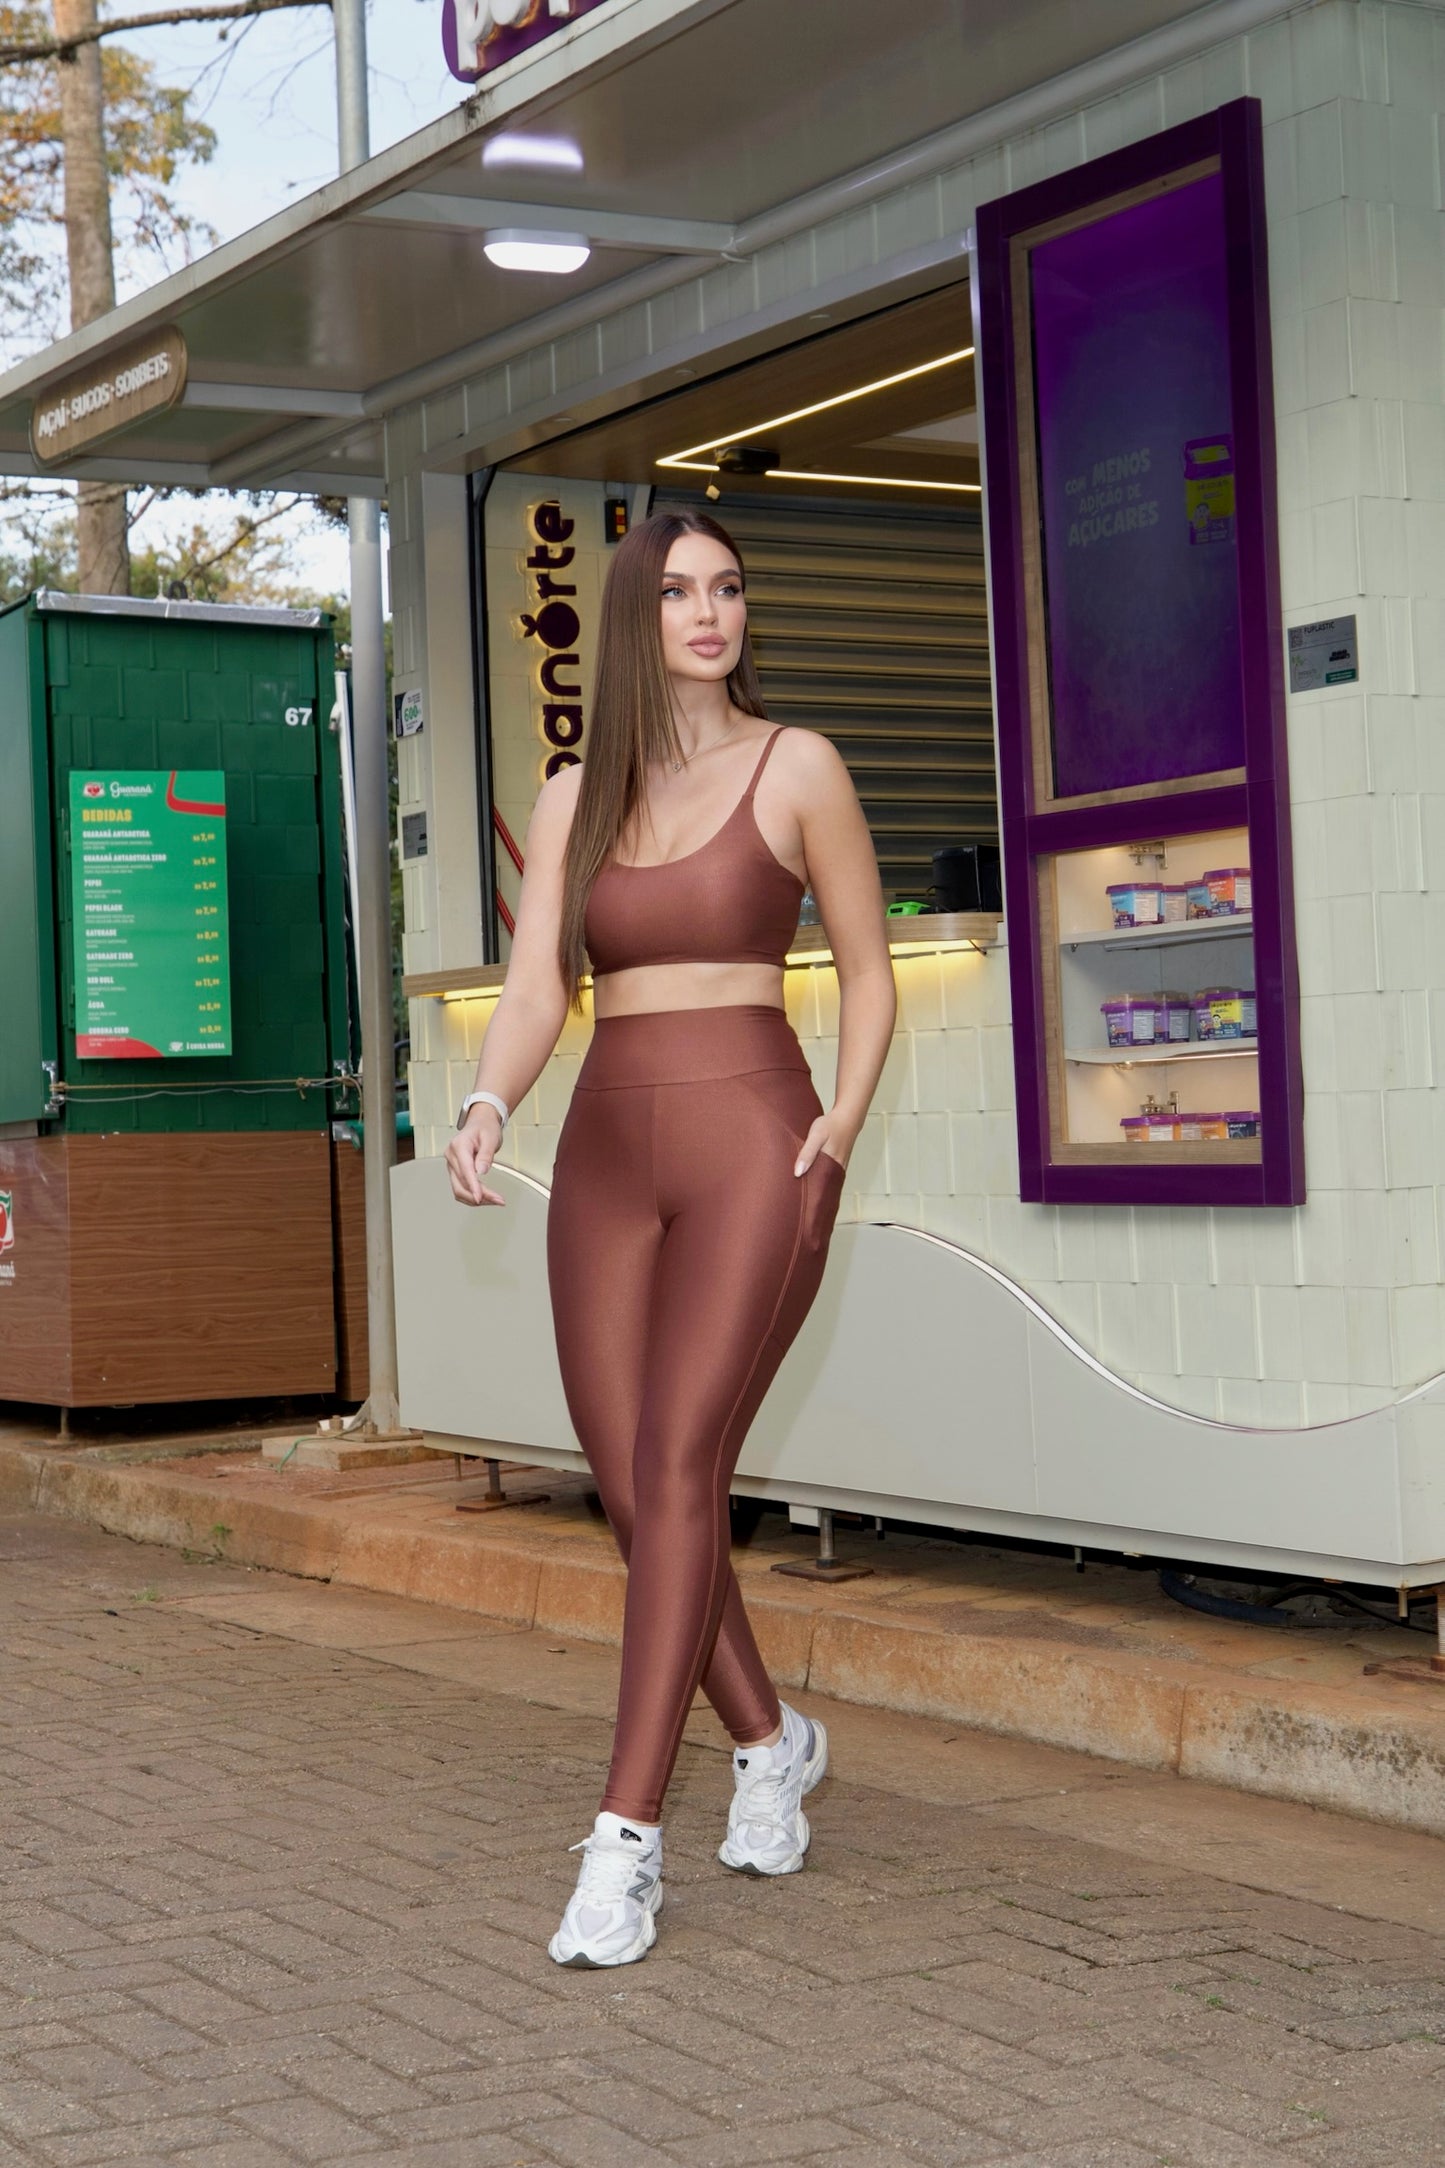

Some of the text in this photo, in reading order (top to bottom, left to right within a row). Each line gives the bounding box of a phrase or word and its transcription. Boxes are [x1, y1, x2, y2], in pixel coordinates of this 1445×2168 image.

[38, 352, 169, 437] AÇAÍ SUCOS SORBETS
[1092, 447, 1151, 487] MENOS
[1127, 483, 1142, 501] DE
[285, 707, 312, 726] 67
[110, 781, 153, 798] Guaraná
[82, 809, 133, 823] BEBIDAS
[82, 829, 112, 839] GUARANÁ
[83, 853, 112, 863] GUARANÁ
[151, 853, 167, 863] ZERO
[84, 879, 102, 888] PEPSI
[85, 904, 124, 913] PEPSI BLACK
[86, 929, 117, 938] GATORADE
[86, 951, 134, 961] GATORADE ZERO
[87, 976, 114, 985] RED BULL
[88, 1000, 105, 1009] ÁGUA
[88, 1026, 114, 1035] CORONA
